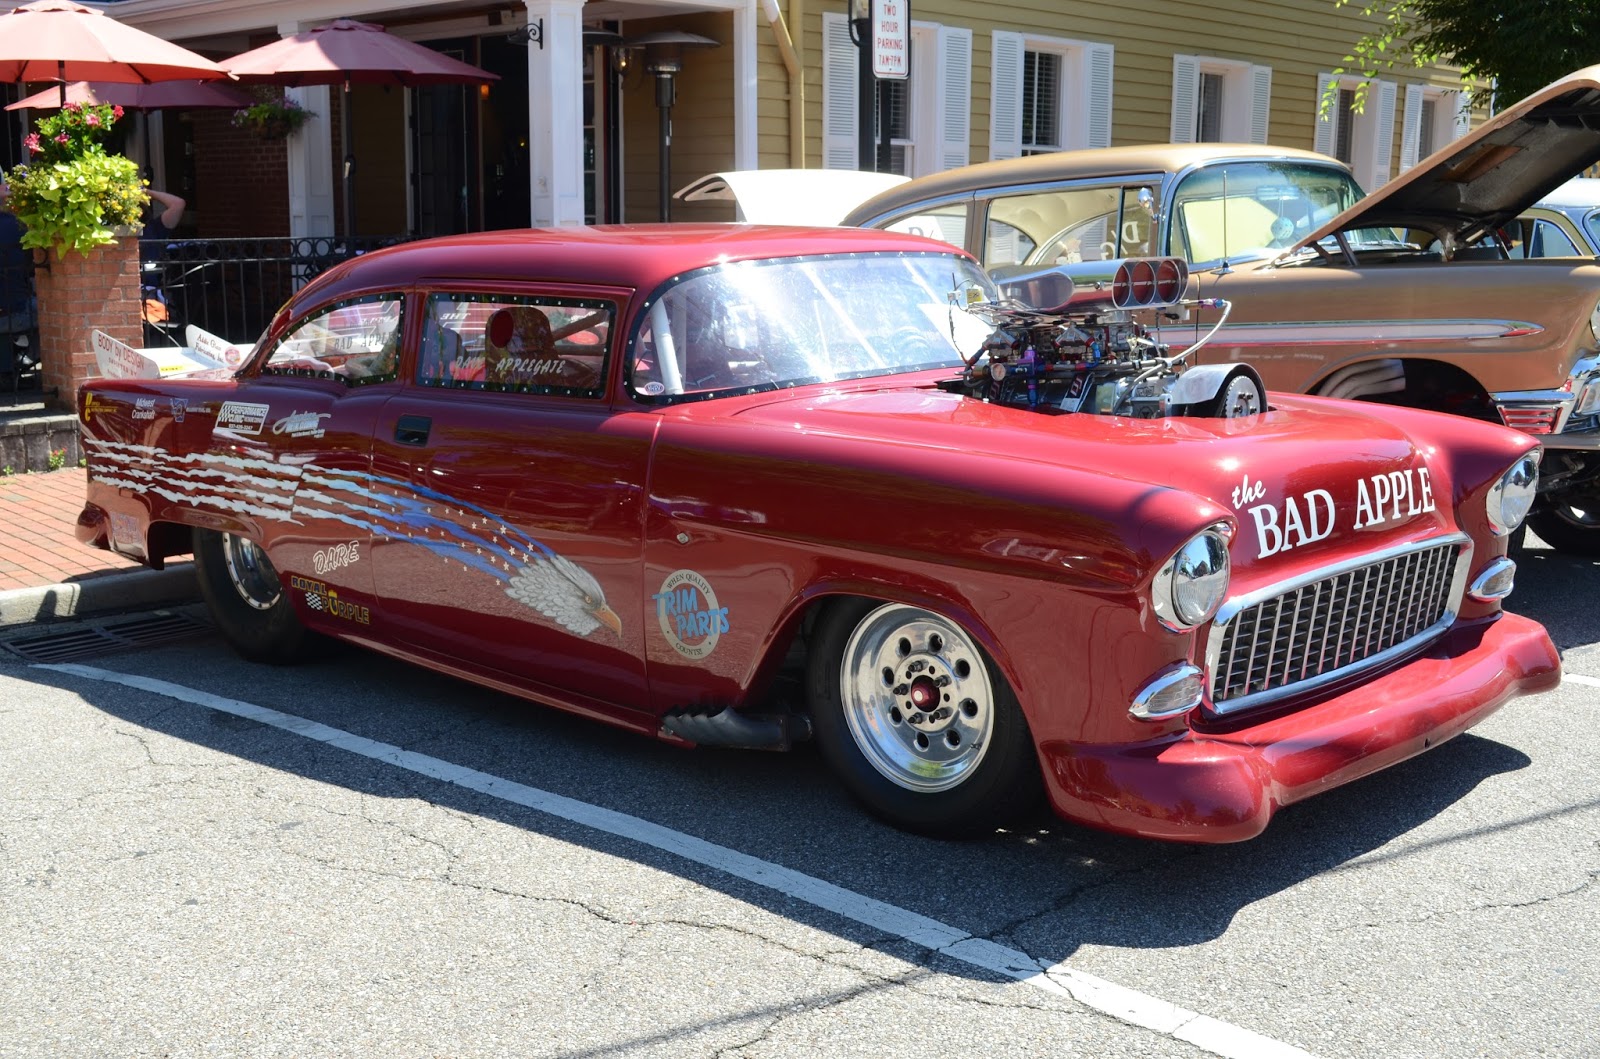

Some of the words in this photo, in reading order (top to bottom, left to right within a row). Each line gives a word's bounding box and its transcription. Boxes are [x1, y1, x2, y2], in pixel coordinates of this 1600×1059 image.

[883, 4, 897, 16] TWO
[881, 21, 899, 33] HOUR
[877, 37, 903, 50] PARKING
[98, 333, 113, 353] BODY
[123, 347, 145, 370] DESIGN
[495, 357, 566, 375] APPLEGATE
[136, 398, 155, 407] Midwest
[229, 405, 267, 417] PERFORMANCE
[131, 409, 155, 420] Crankshaft
[1231, 474, 1267, 509] the
[1248, 489, 1336, 559] BAD
[1353, 467, 1436, 530] APPLE
[291, 575, 327, 596] ROYAL
[667, 573, 685, 589] WHEN
[685, 573, 711, 595] QUALITY
[321, 589, 370, 624] PURPLE
[652, 587, 698, 618] TRIM
[675, 607, 730, 641] PARTS
